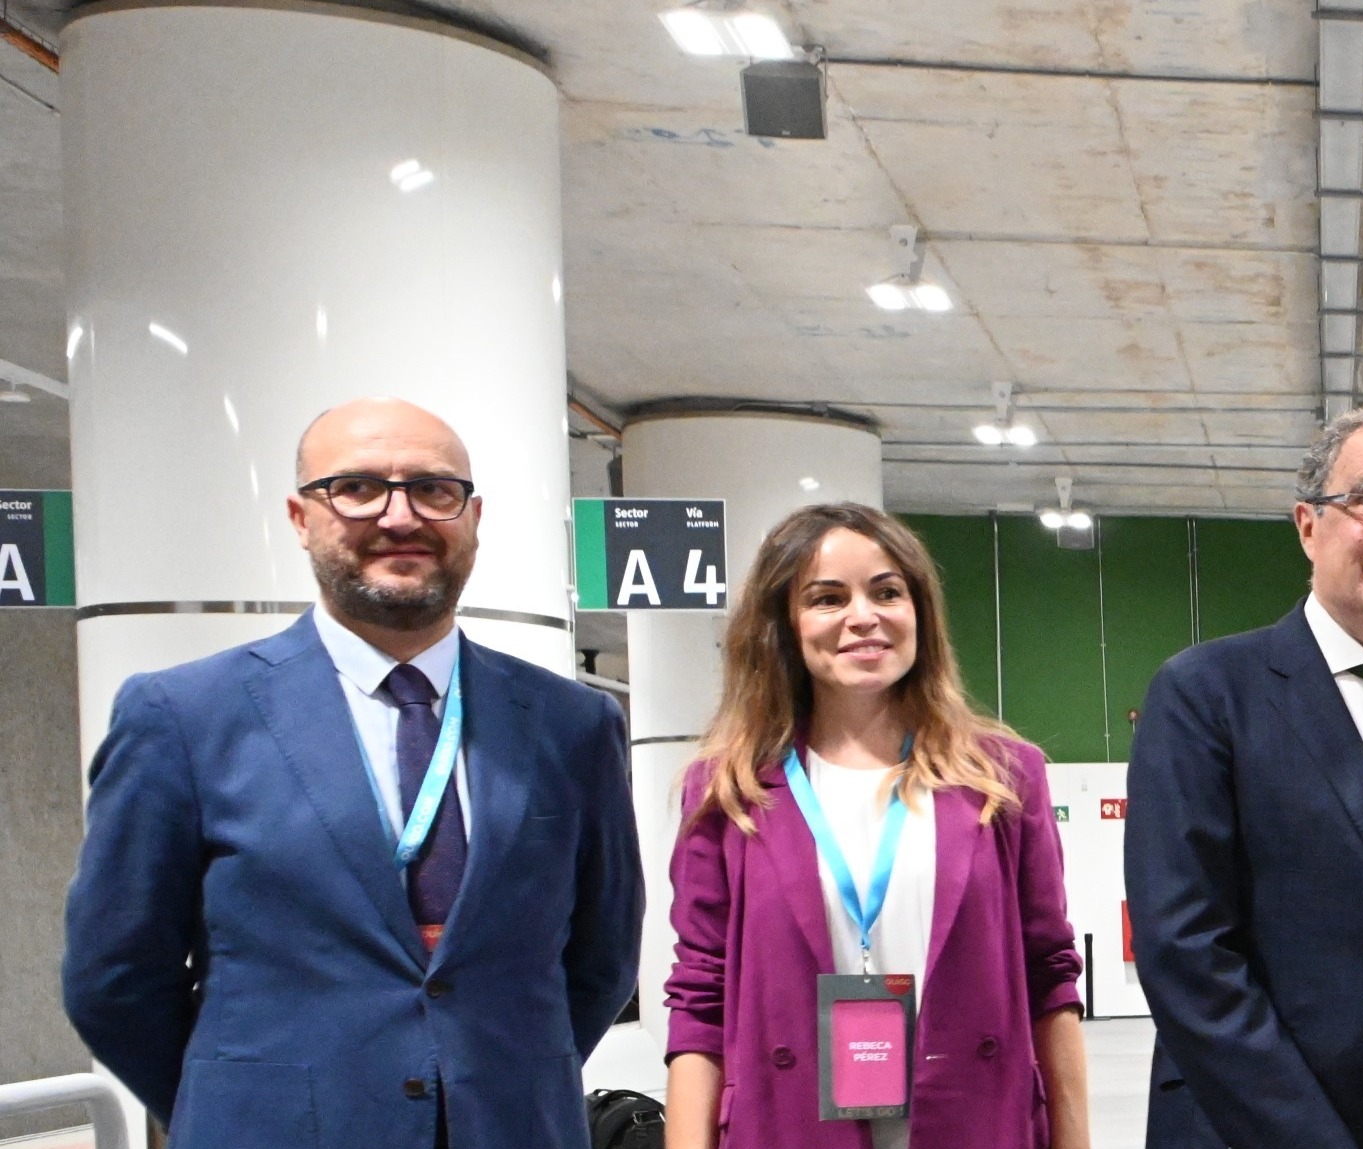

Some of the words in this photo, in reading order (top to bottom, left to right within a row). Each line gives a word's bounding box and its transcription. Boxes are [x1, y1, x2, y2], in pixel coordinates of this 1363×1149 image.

[0, 500, 33, 510] ector
[614, 507, 649, 519] Sector
[686, 507, 703, 518] Vía
[0, 543, 35, 601] A
[617, 549, 661, 605] A
[683, 549, 726, 605] 4
[849, 1041, 893, 1050] REBECA
[853, 1051, 889, 1062] PÉREZ
